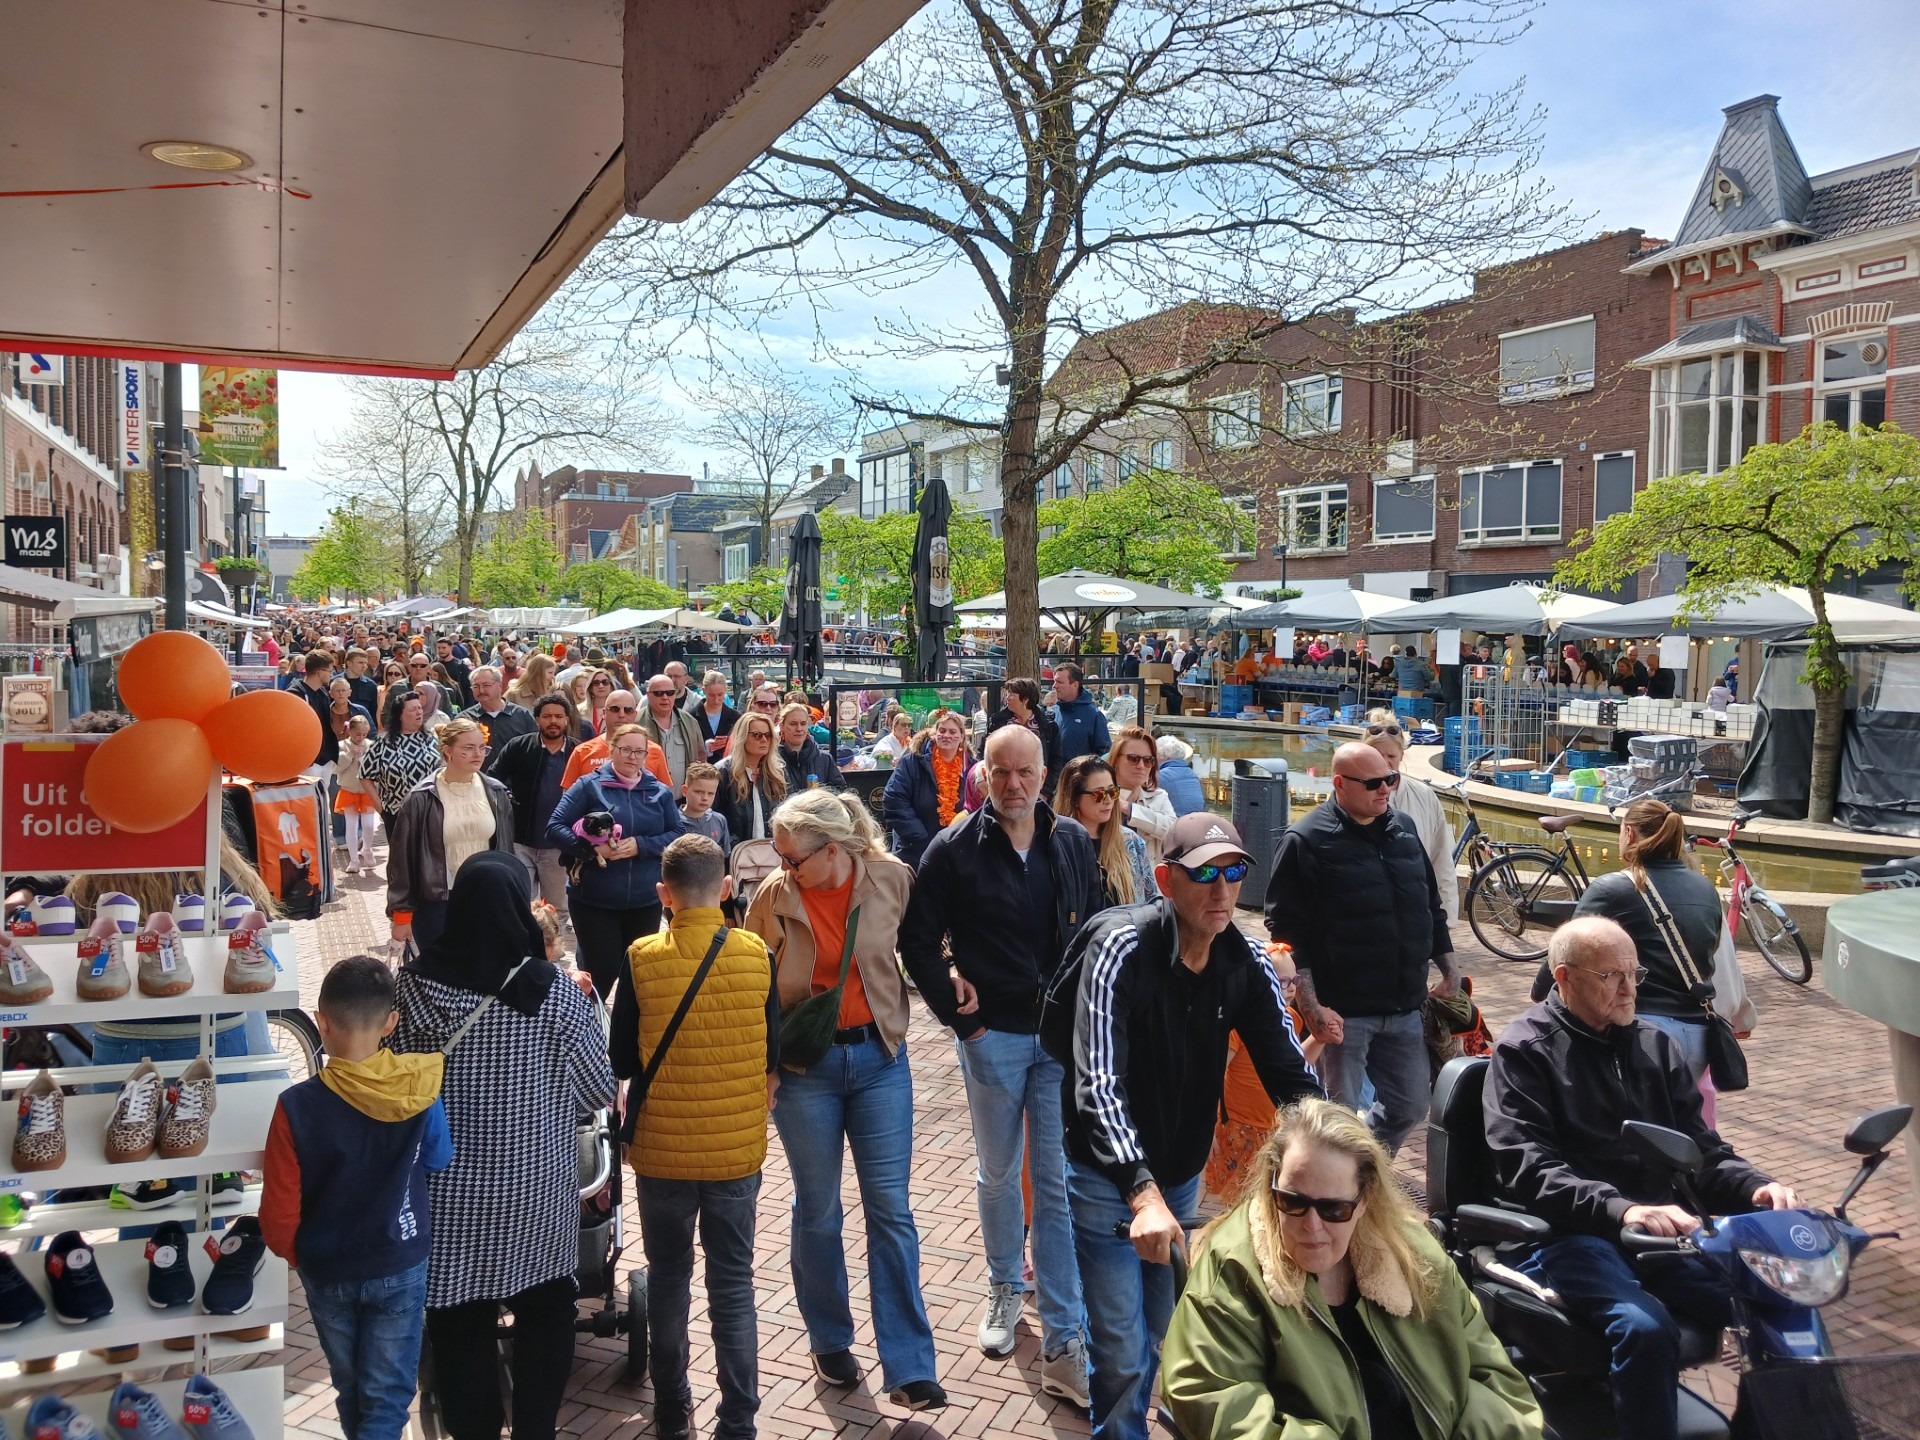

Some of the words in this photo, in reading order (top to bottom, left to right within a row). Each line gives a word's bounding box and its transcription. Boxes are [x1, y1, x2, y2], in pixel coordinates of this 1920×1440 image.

[126, 366, 139, 450] INTERSPORT
[12, 683, 44, 691] WANTED
[23, 783, 68, 806] Uit
[14, 922, 34, 930] 50%
[139, 935, 156, 943] 50%
[80, 940, 98, 949] 50%
[188, 1405, 206, 1415] 50%
